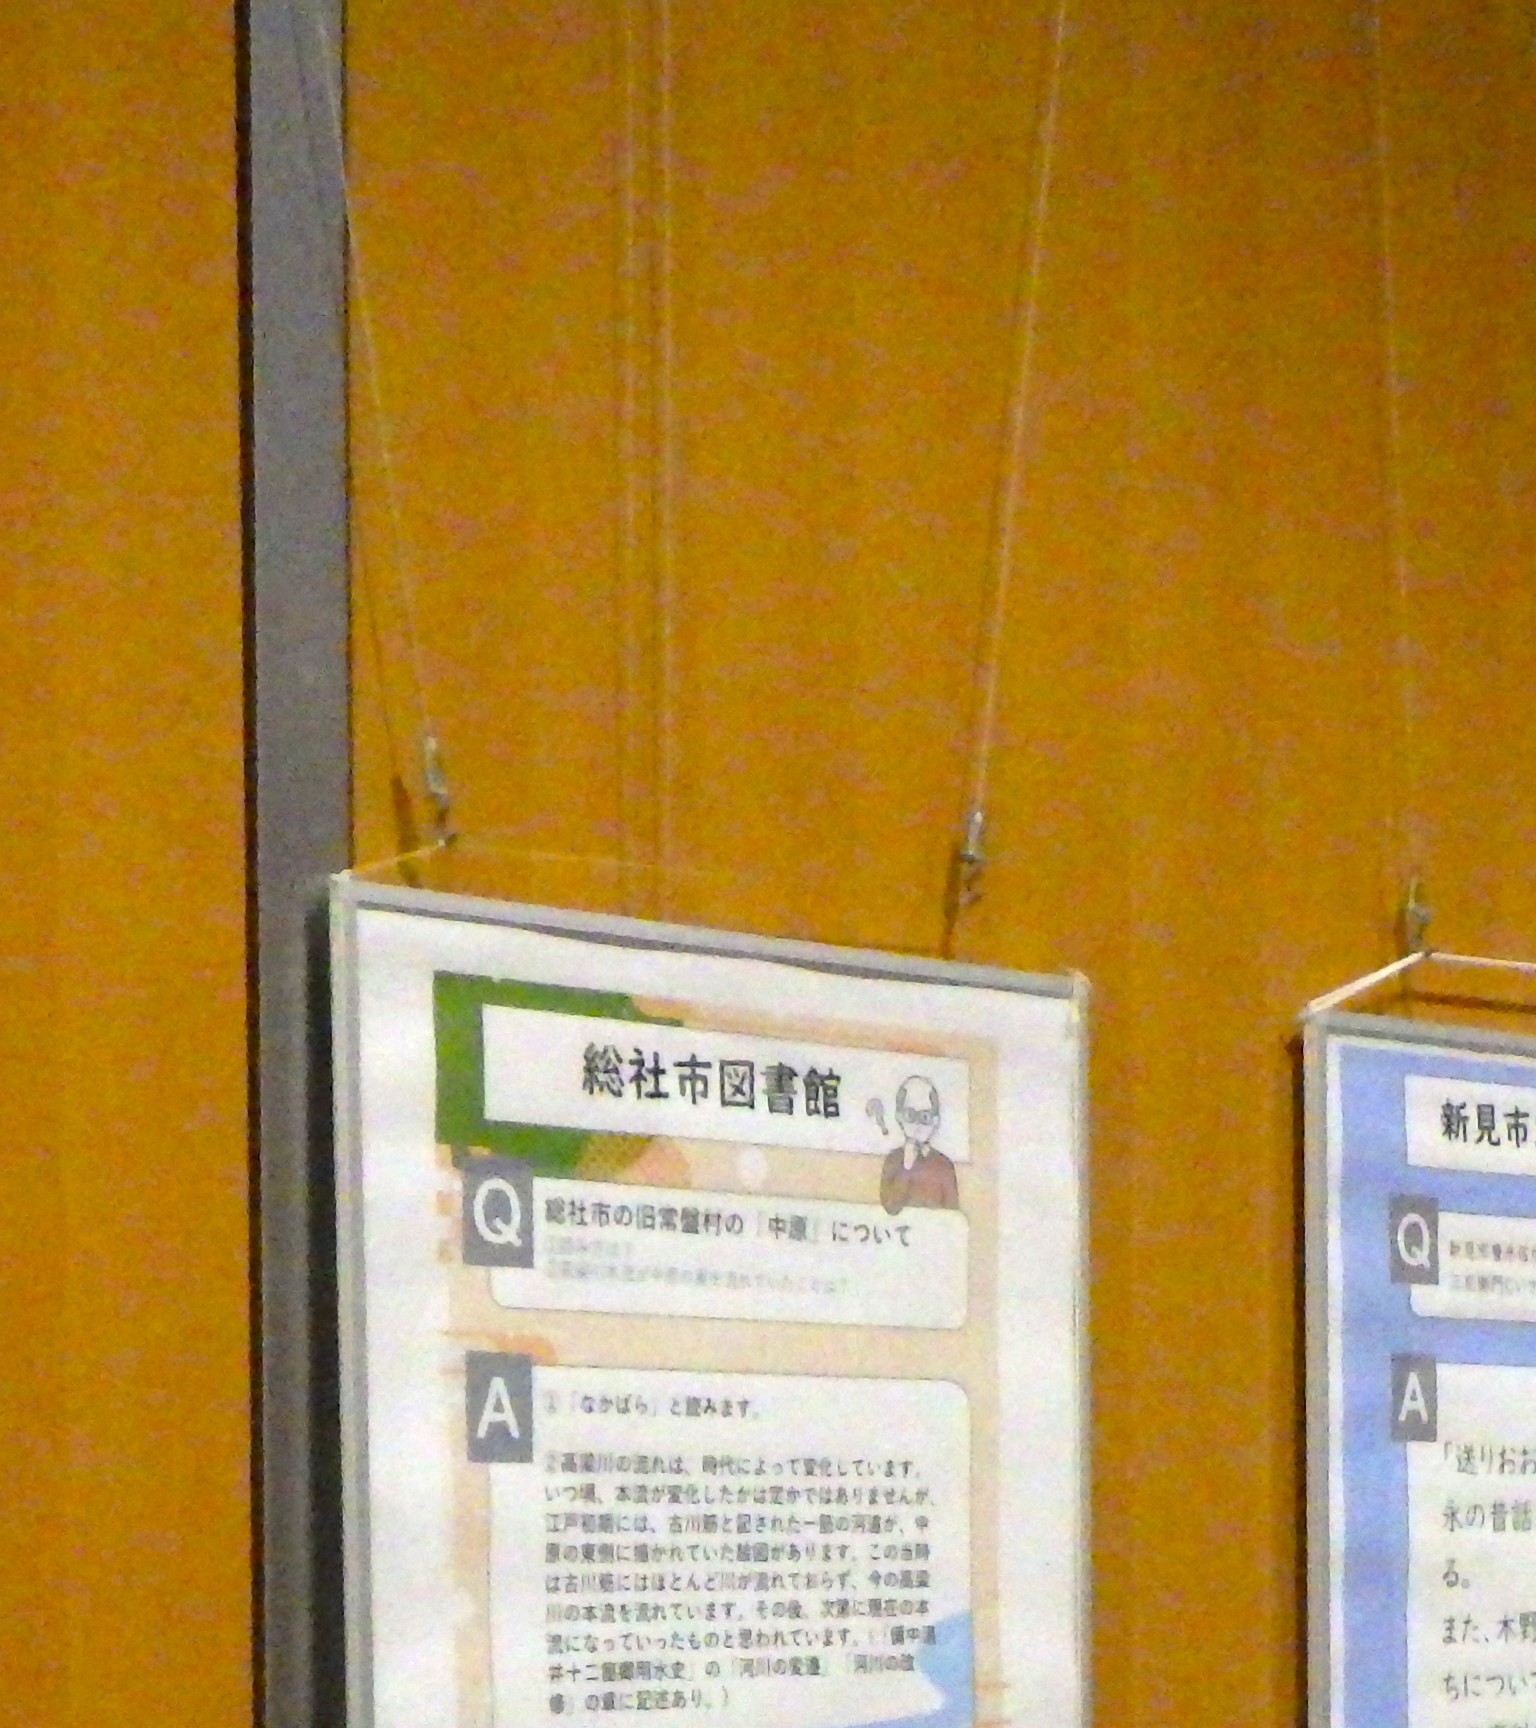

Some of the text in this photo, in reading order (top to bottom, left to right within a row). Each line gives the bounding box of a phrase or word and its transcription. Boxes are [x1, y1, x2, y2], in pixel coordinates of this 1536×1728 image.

[583, 1042, 842, 1119] 総社市図書館
[473, 1177, 523, 1248] Q
[1397, 1212, 1432, 1269] Q
[476, 1376, 521, 1441] A
[1398, 1371, 1429, 1425] A
